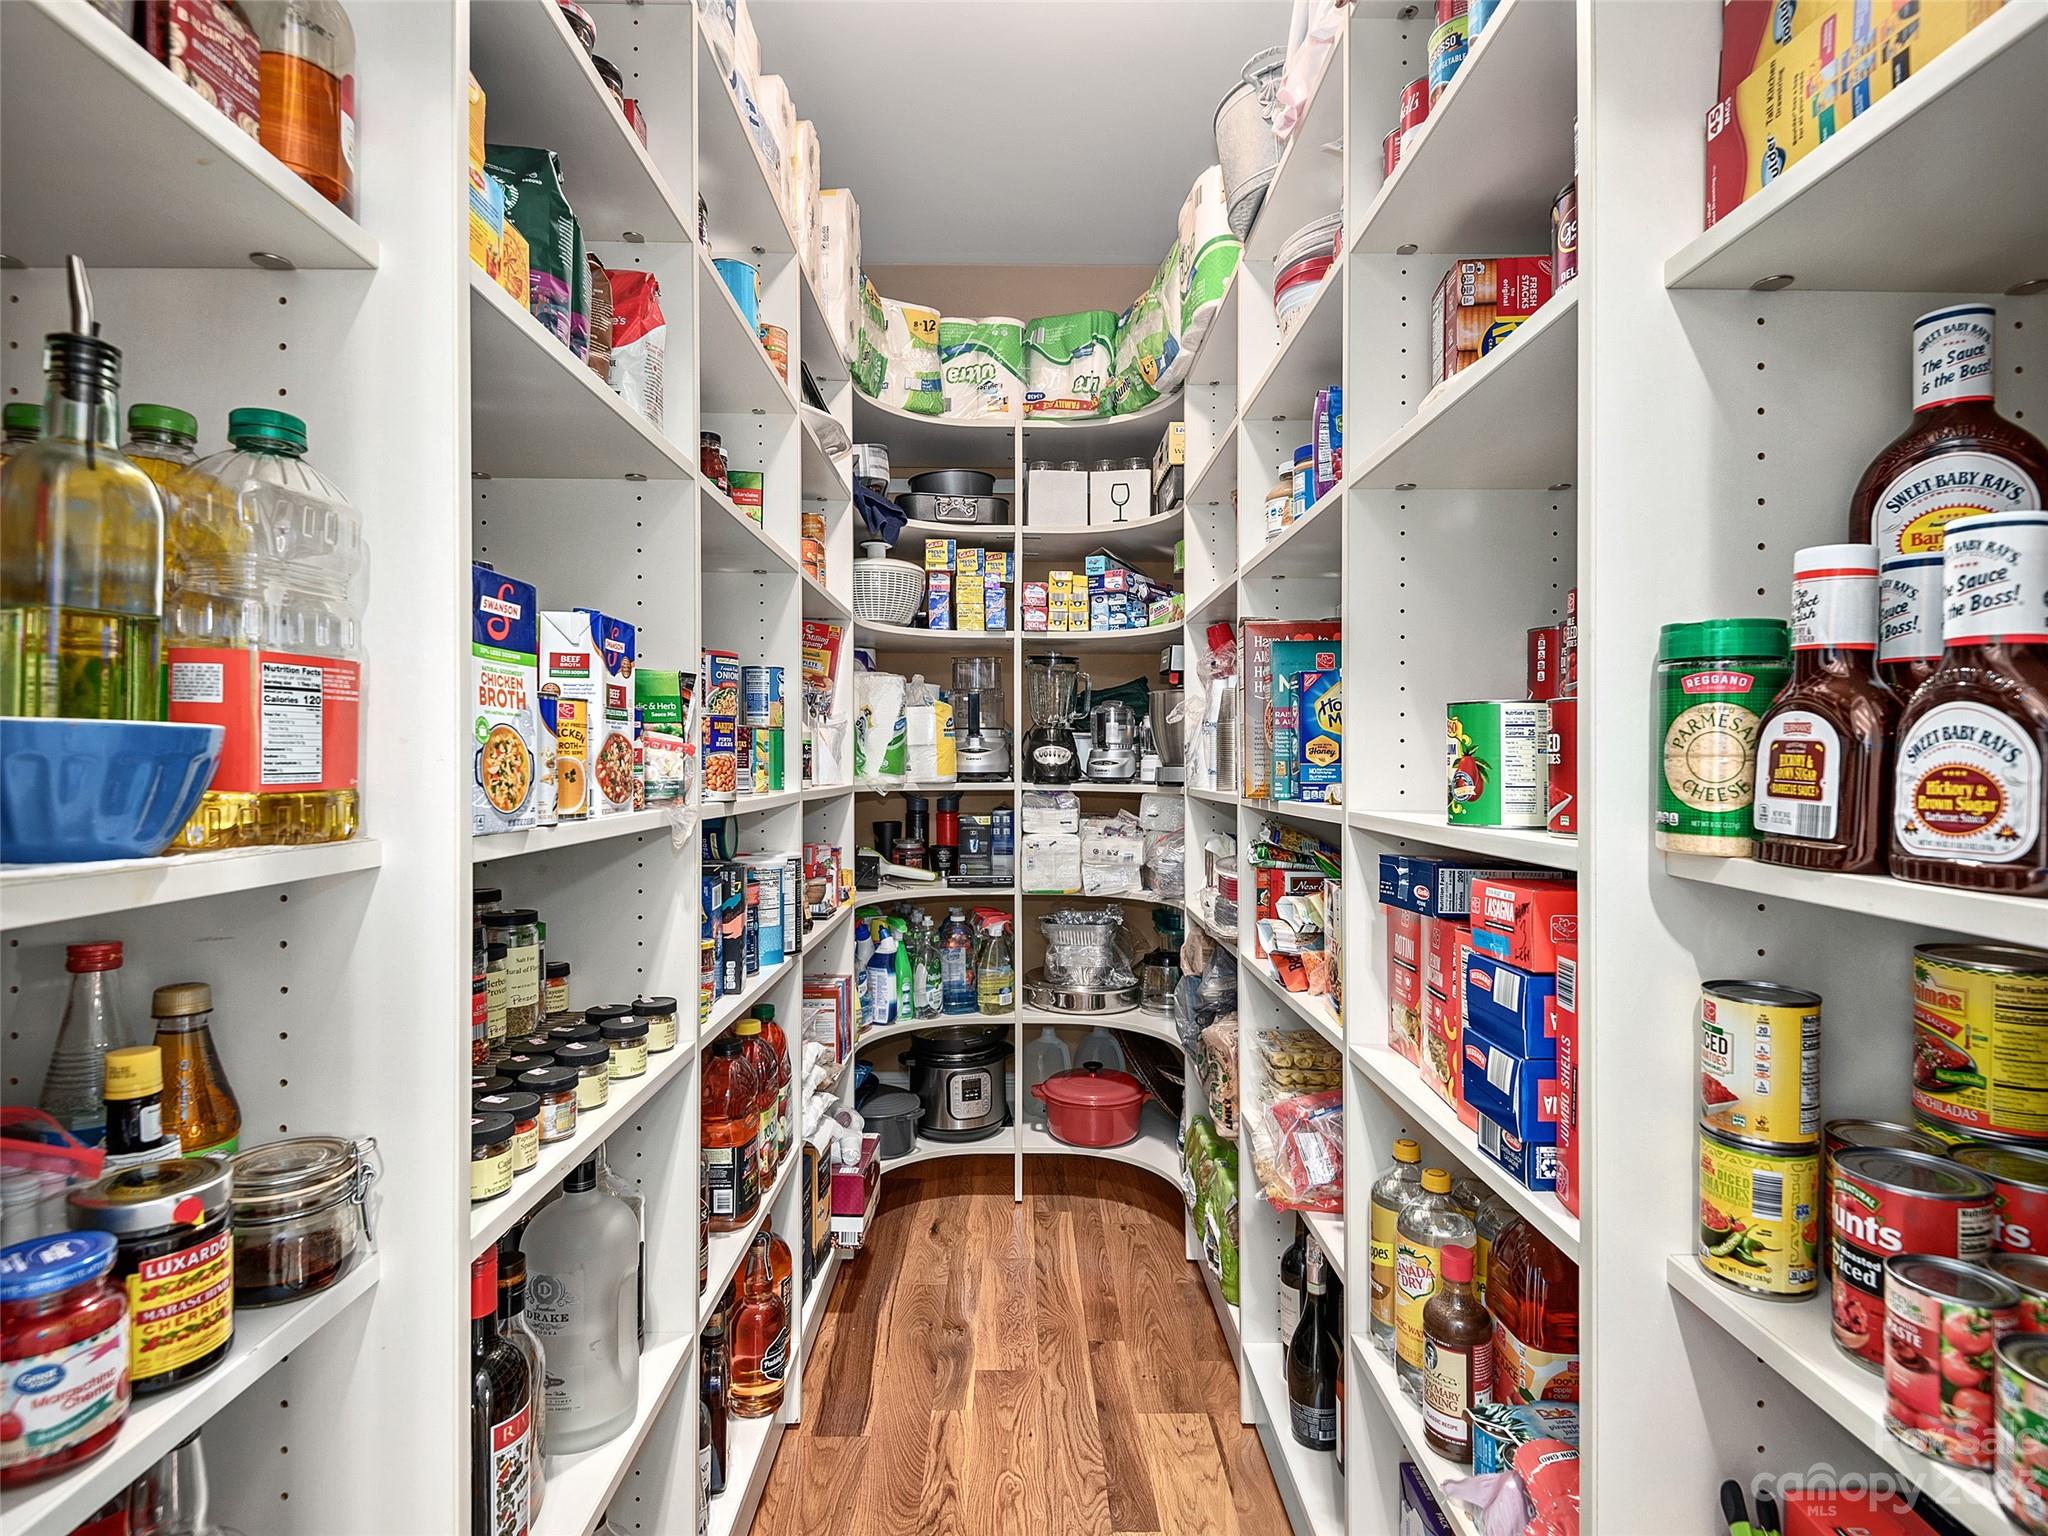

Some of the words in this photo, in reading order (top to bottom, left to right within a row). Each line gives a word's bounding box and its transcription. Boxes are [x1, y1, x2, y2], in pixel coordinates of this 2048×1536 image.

[1766, 59, 1776, 104] Kitchen
[1711, 106, 1722, 136] 45
[1724, 97, 1732, 126] BAGS
[1766, 105, 1774, 126] Tall
[1767, 134, 1780, 178] ulder
[1521, 274, 1529, 309] STACKS
[1529, 276, 1538, 307] FRESH
[613, 316, 626, 326] e's
[1918, 328, 1941, 354] SWEET
[1943, 322, 1969, 335] BABY
[1971, 324, 1992, 345] RAY'S
[1921, 357, 1942, 376] The
[1946, 344, 1985, 364] Sauce
[1921, 381, 1931, 395] is
[1934, 370, 1953, 388] the
[1960, 357, 1993, 378] Boss!
[1057, 398, 1080, 411] FAMILY
[1886, 477, 1933, 514] SWEET
[1936, 472, 1976, 488] BABY
[1980, 473, 2026, 501] RAY'S
[1956, 540, 1985, 552] BABY
[1985, 541, 2021, 564] RAY'S
[1893, 580, 1918, 600] RAY'S
[1957, 567, 2009, 592] Sauce
[483, 598, 519, 617] SWANSON
[1970, 584, 2021, 612] Boss!
[1885, 615, 1919, 639] Boss!
[560, 655, 581, 663] BEEF
[264, 664, 300, 675] Nutrition
[302, 667, 321, 676] Facts
[481, 672, 523, 689] CHICKEN
[1686, 675, 1748, 688] REGGANO
[264, 695, 299, 705] Calories
[303, 695, 322, 705] 120
[479, 686, 527, 710] BROTH
[657, 702, 676, 710] Herb
[1549, 734, 1560, 748] ED
[1672, 713, 1756, 750] PARMESAN
[1309, 747, 1336, 757] Honey
[1907, 730, 1940, 764] SWEET
[1942, 725, 1979, 742] BABY
[1979, 730, 2023, 763] RAY'S
[1795, 768, 1817, 781] SUGAR
[1682, 779, 1752, 802] CHEESE
[1798, 785, 1816, 796] SAUCE
[1926, 781, 1974, 798] Hickory
[1975, 785, 1988, 797] &
[1918, 796, 1953, 810] Brown
[1955, 797, 1998, 815] Sugar
[1924, 813, 1959, 823] Barbecue
[1960, 814, 1987, 823] Sauce
[1293, 880, 1318, 891] Near
[1484, 897, 1515, 922] LASAGNA
[1395, 933, 1415, 961] ROTINI
[1995, 984, 2025, 994] Nutrition
[1926, 1013, 1953, 1034] SAUCE
[1704, 1032, 1728, 1055] CED
[1560, 1036, 1571, 1089] SHELLS
[1560, 1092, 1569, 1147] JUMBO
[1717, 1169, 1749, 1188] DICED
[1833, 1205, 1903, 1252] unt's
[145, 1236, 228, 1279] LUXARDO
[1398, 1264, 1436, 1279] ANADA
[1718, 1262, 1728, 1271] NET
[1728, 1264, 1737, 1273] WT
[1745, 1270, 1752, 1279] OZ
[1832, 1252, 1878, 1289] Diced
[1401, 1275, 1423, 1290] DRY
[143, 1279, 229, 1320] MARASCHINO
[143, 1294, 228, 1335] CHERRIES
[526, 1313, 569, 1323] DRAKE
[1408, 1325, 1424, 1338] WAT
[1424, 1391, 1458, 1412] ONING
[1553, 1387, 1573, 1396] apple
[1536, 1408, 1573, 1419] Dole
[1541, 1450, 1579, 1463] NON-GMO
